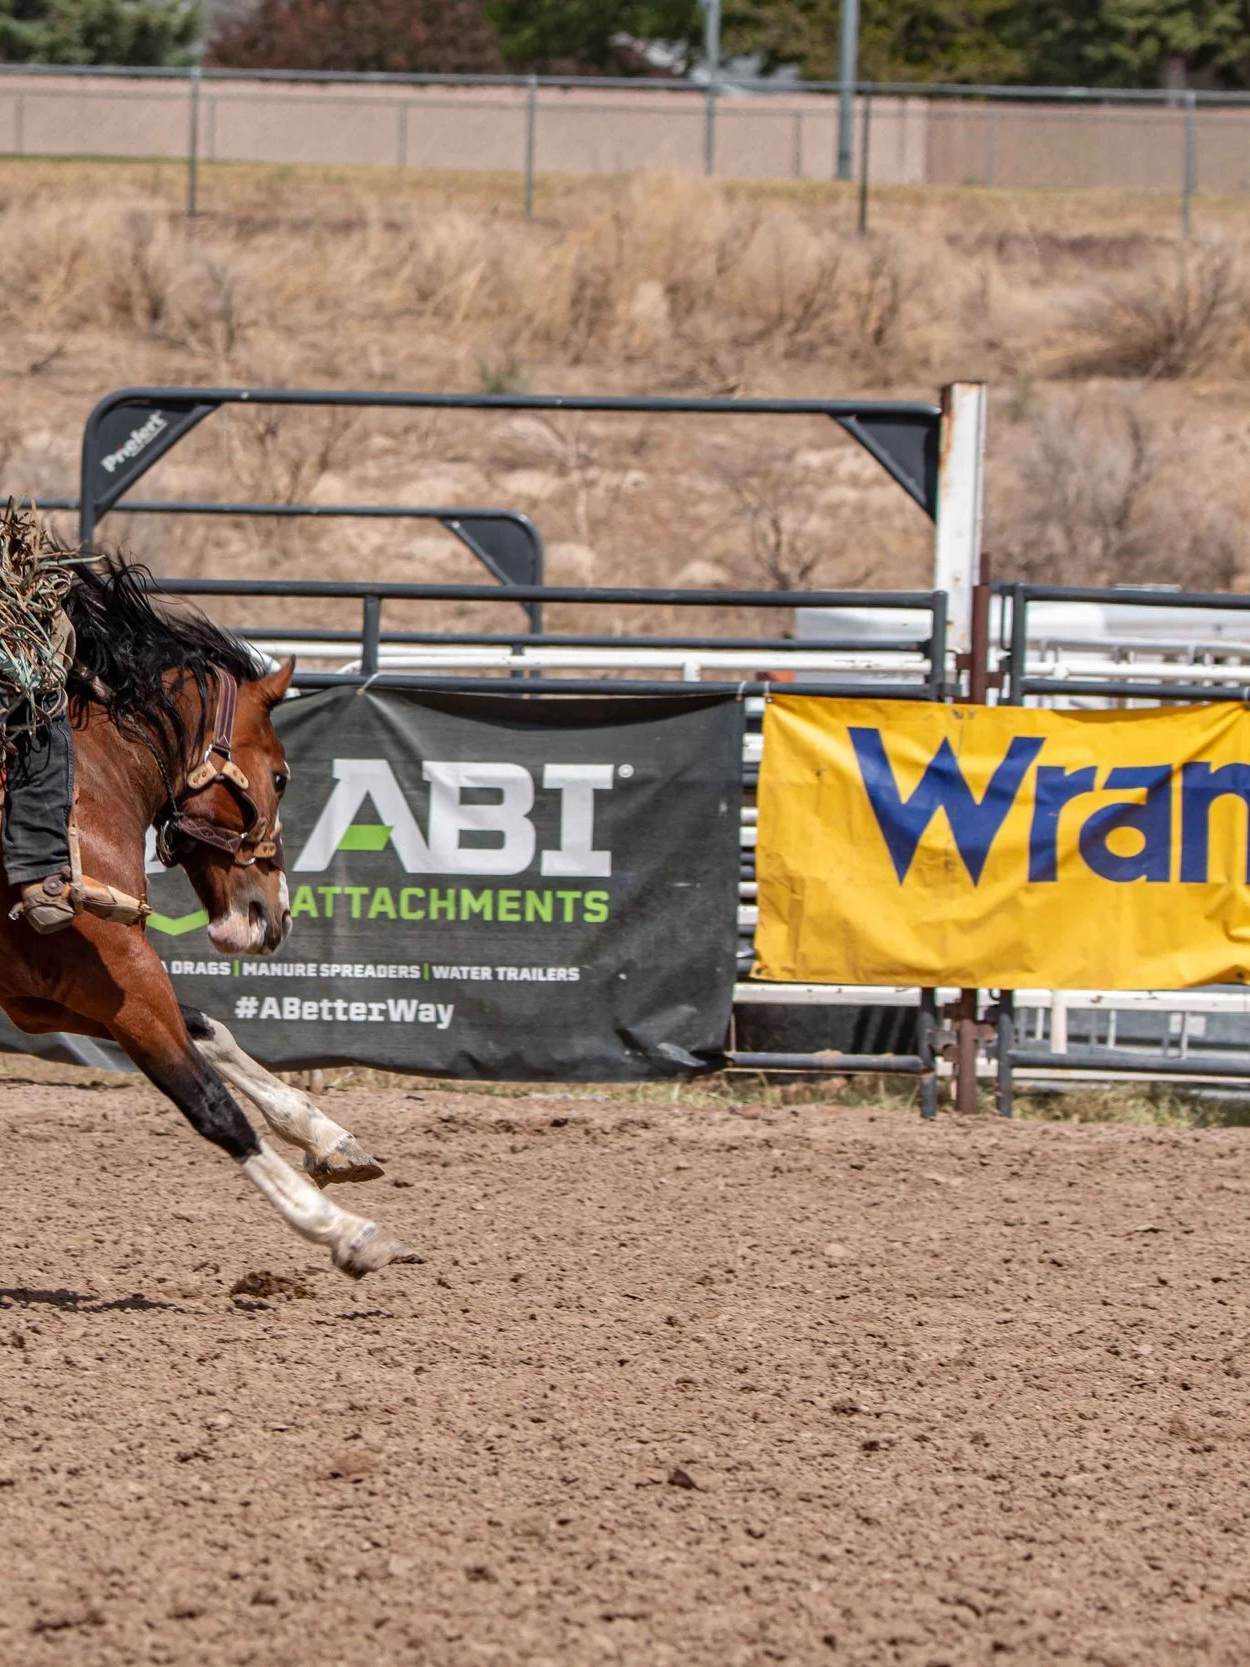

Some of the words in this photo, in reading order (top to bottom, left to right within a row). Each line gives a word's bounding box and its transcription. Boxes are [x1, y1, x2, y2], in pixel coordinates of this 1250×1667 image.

[292, 757, 615, 878] ABI
[847, 726, 1250, 888] Wran
[290, 885, 610, 924] ATTACHMENTS
[171, 961, 231, 975] DRAGS
[243, 962, 318, 977] MANURE
[319, 963, 421, 979] SPREADERS
[432, 965, 493, 980] WATER
[495, 967, 580, 981] TRAILERS
[235, 996, 454, 1030] #ABetterWay
